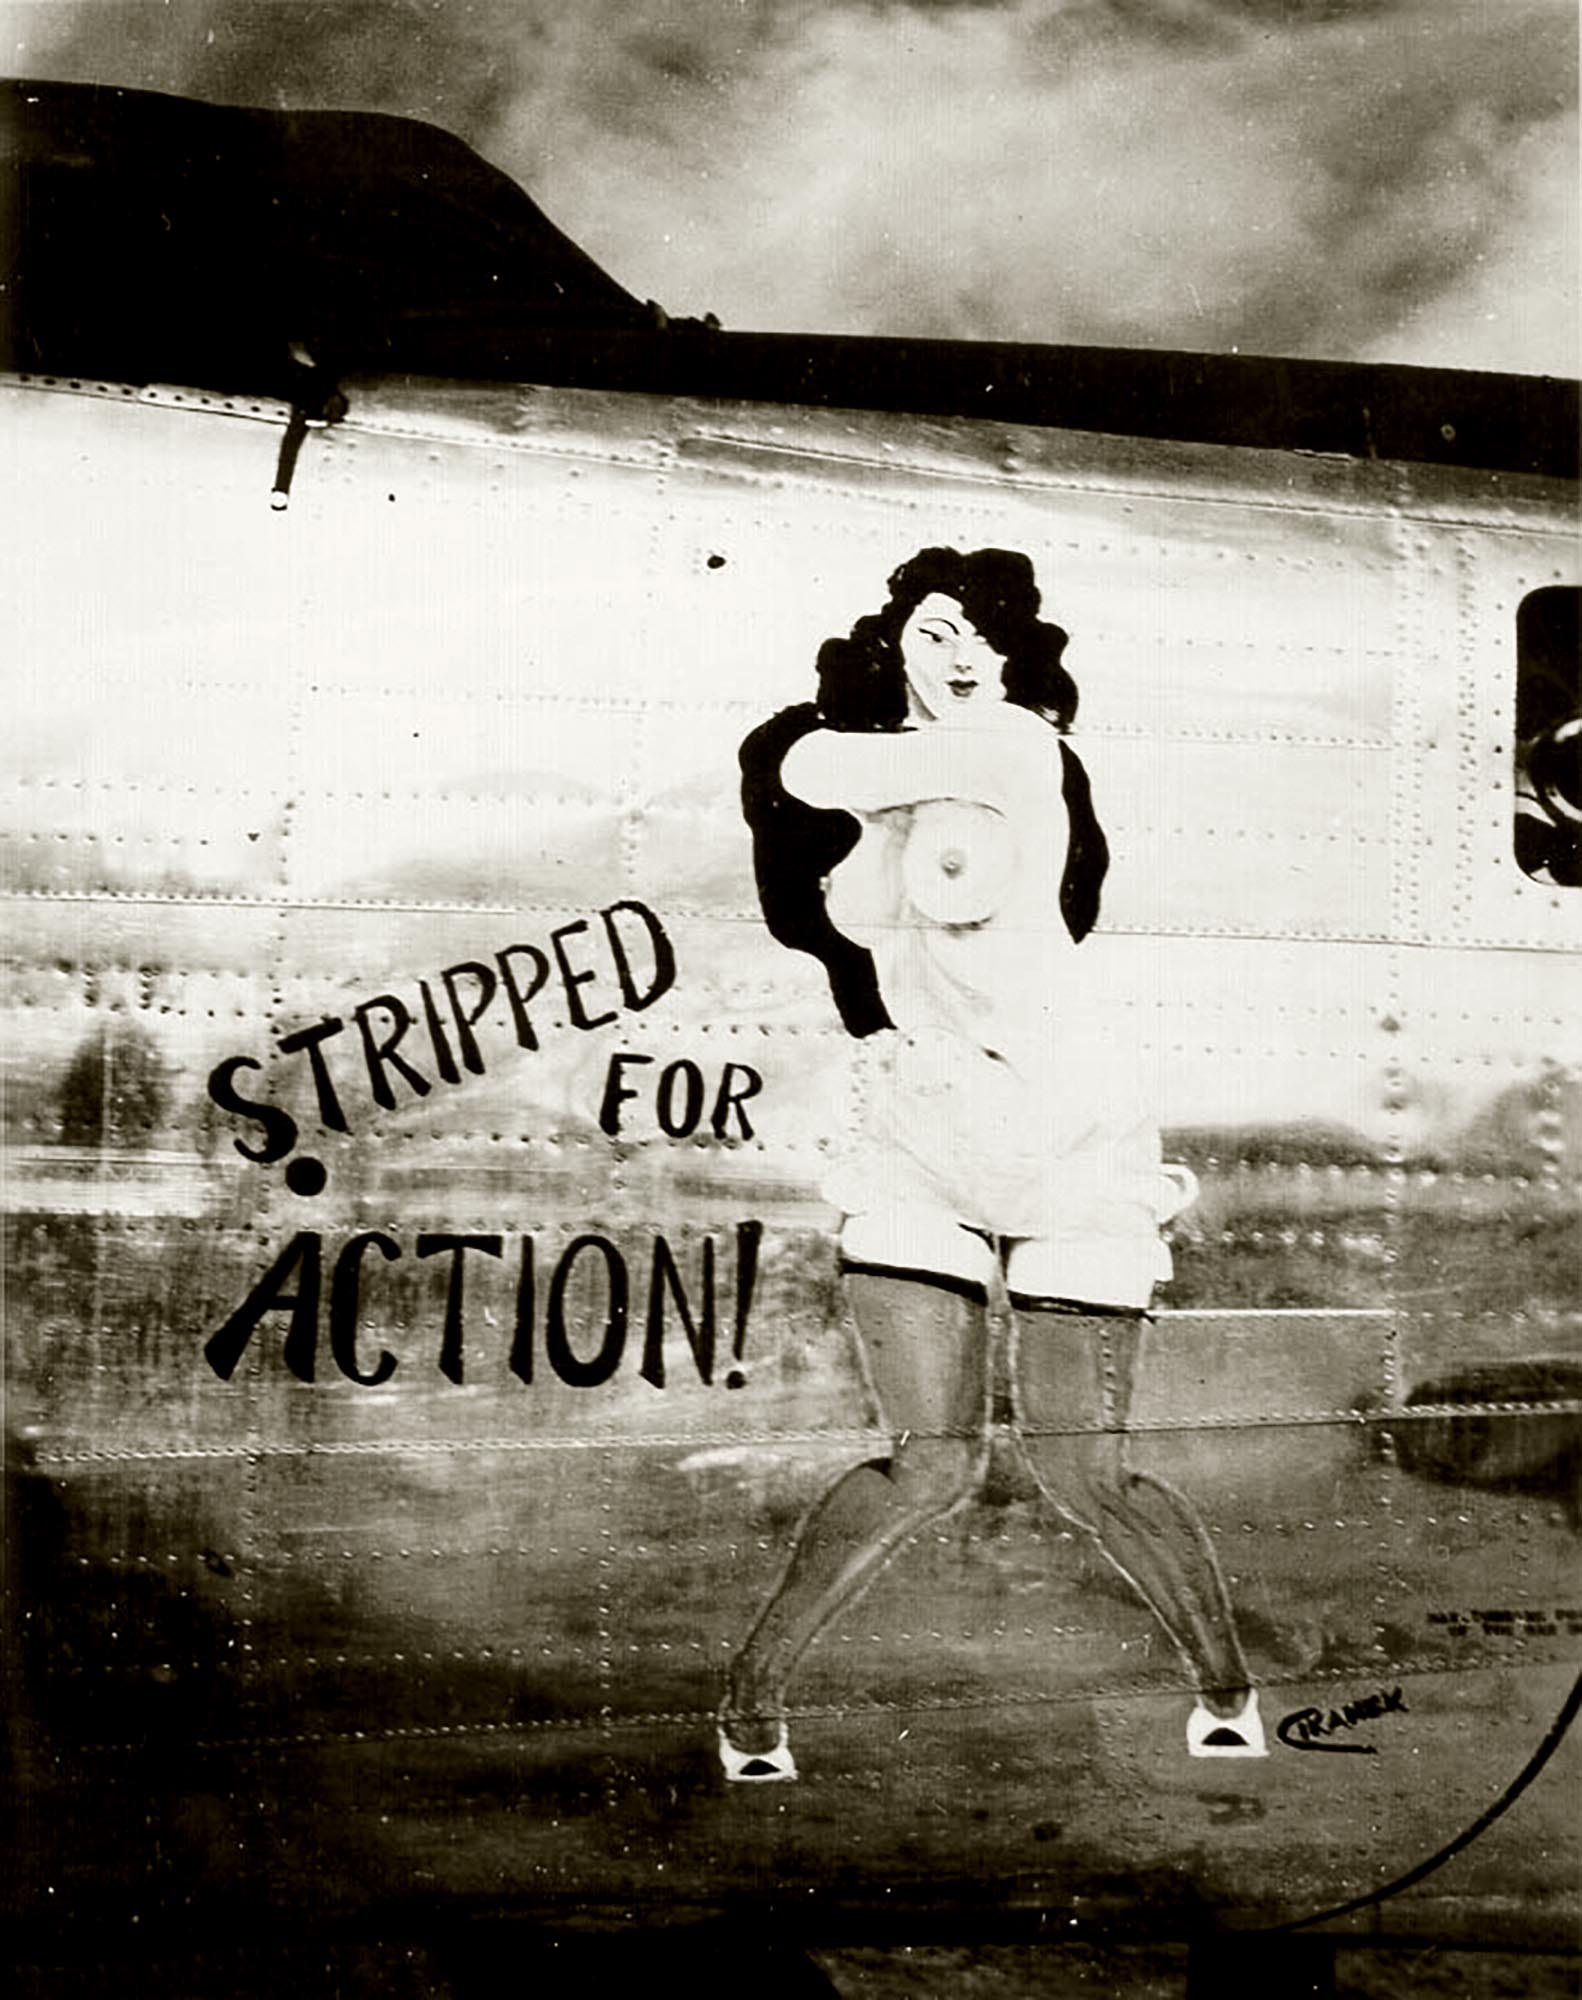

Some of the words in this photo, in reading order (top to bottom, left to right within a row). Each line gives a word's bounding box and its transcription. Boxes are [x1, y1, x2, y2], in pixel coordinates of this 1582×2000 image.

[207, 900, 677, 1163] STRIPPED
[599, 1052, 763, 1141] FOR
[204, 1219, 763, 1389] ACTION!
